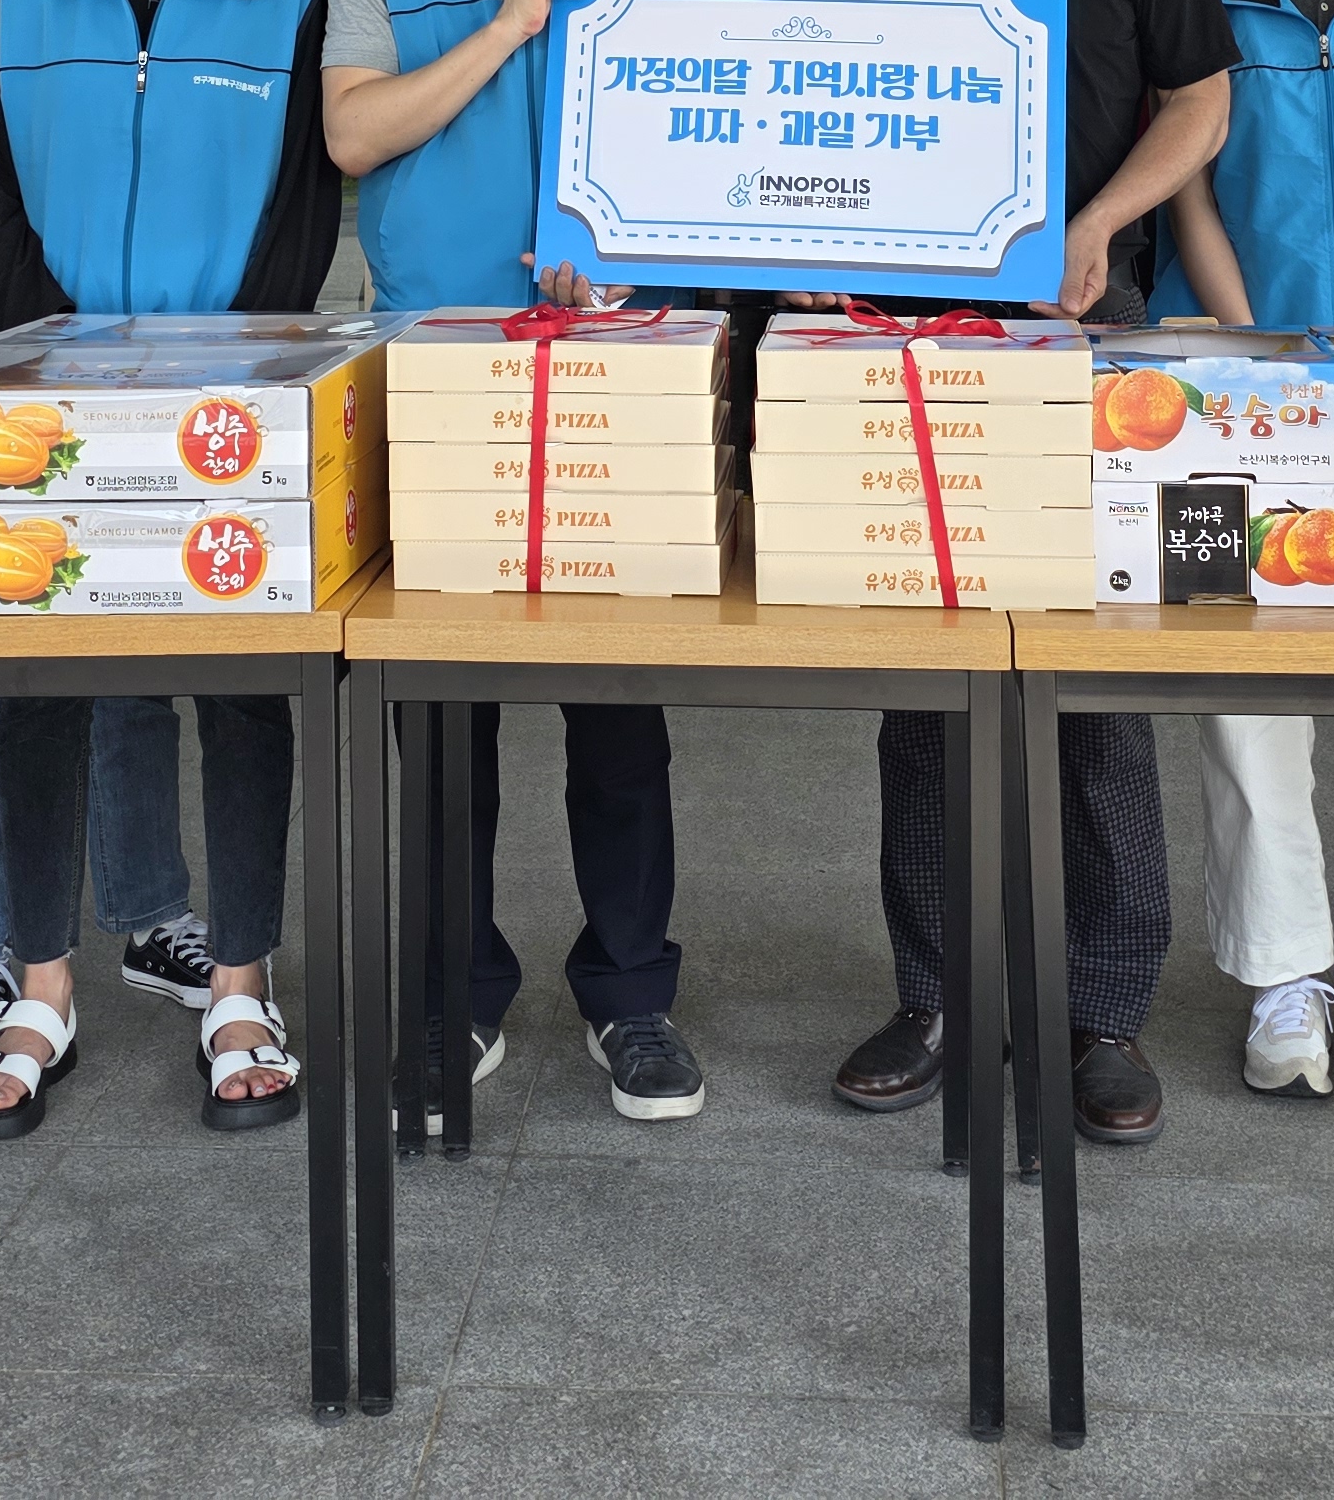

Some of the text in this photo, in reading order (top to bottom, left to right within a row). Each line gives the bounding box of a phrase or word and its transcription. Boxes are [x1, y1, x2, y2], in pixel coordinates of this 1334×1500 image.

[603, 56, 1004, 105] 가정의달 지역사랑 나눔
[667, 106, 941, 152] 피자 과일 기부
[759, 174, 871, 195] INNOPOLIS
[758, 193, 871, 210] 연구개발특구진흥재단
[490, 359, 521, 378] 유성
[552, 361, 607, 377] PIZZA
[864, 366, 985, 387] 유성 PIZZA
[1279, 383, 1324, 400] 황산벌
[83, 411, 179, 421] SEONGJU CHAMOE
[492, 409, 610, 429] 유성 PIZZA
[1200, 391, 1330, 440] 복숭아
[192, 408, 248, 456] 성주
[862, 419, 894, 439] 유성
[928, 422, 985, 438] PIZZA
[202, 451, 239, 476] 참외
[493, 460, 610, 479] 유성 PIZZA
[1106, 457, 1133, 473] 2kg
[1238, 454, 1331, 467] 논산시복숭아연구회
[261, 470, 287, 485] 5 kg
[861, 467, 983, 491] 유성 1365 IZZA
[494, 508, 612, 528] 유성 PIZZA
[1178, 505, 1225, 526] 가야곡
[87, 527, 184, 536] SEONGJU CHAMOE
[863, 523, 895, 543] 유성
[900, 519, 922, 529] 1365
[197, 523, 254, 572] 성주
[1165, 529, 1243, 562] 복숭아
[498, 558, 528, 578] 유성
[560, 561, 616, 577] PIZZA
[206, 567, 245, 592] 참외
[865, 569, 987, 592] 유성 1365 PZZA
[1112, 575, 1129, 587] 2kg
[267, 586, 293, 601] 5 kg
